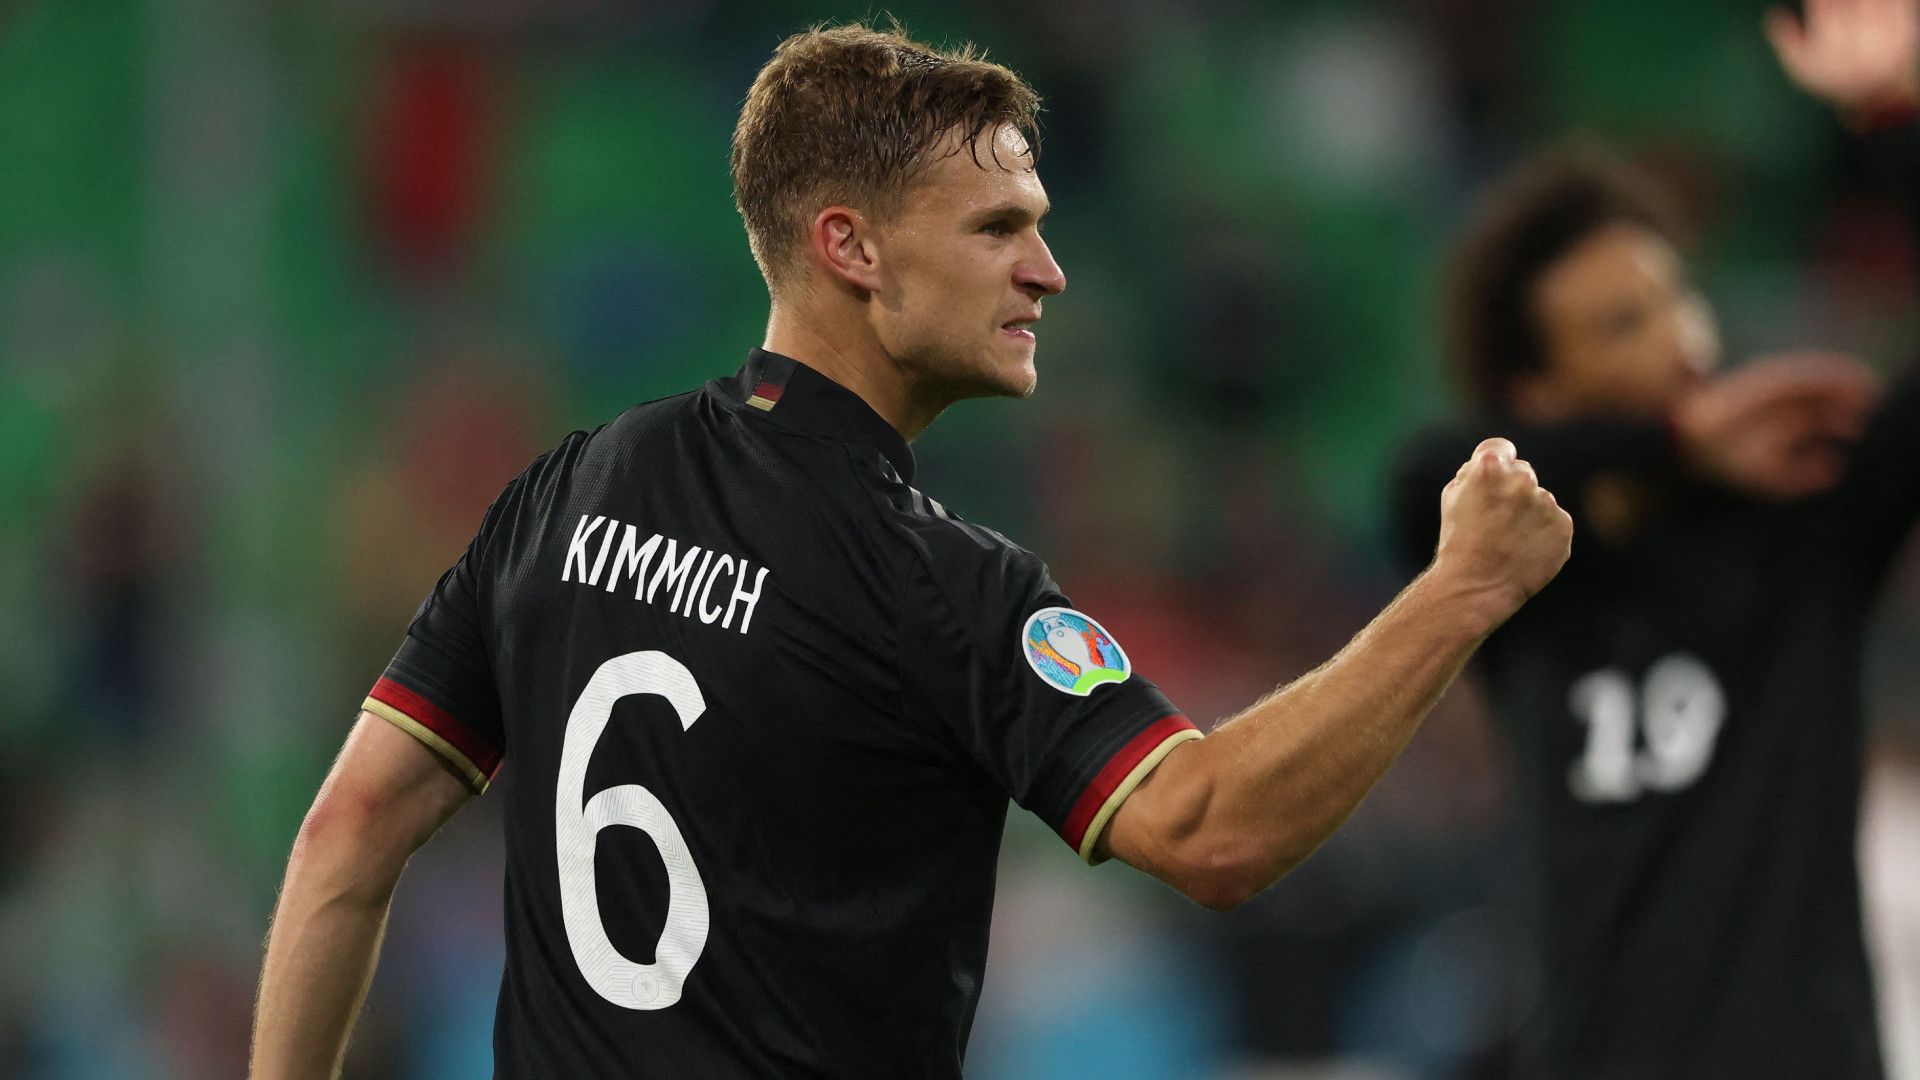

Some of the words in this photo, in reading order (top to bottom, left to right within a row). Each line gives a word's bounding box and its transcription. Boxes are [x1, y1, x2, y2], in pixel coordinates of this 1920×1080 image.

[561, 514, 770, 634] KIMMICH
[1569, 654, 1727, 801] 19
[556, 650, 709, 1010] 6
